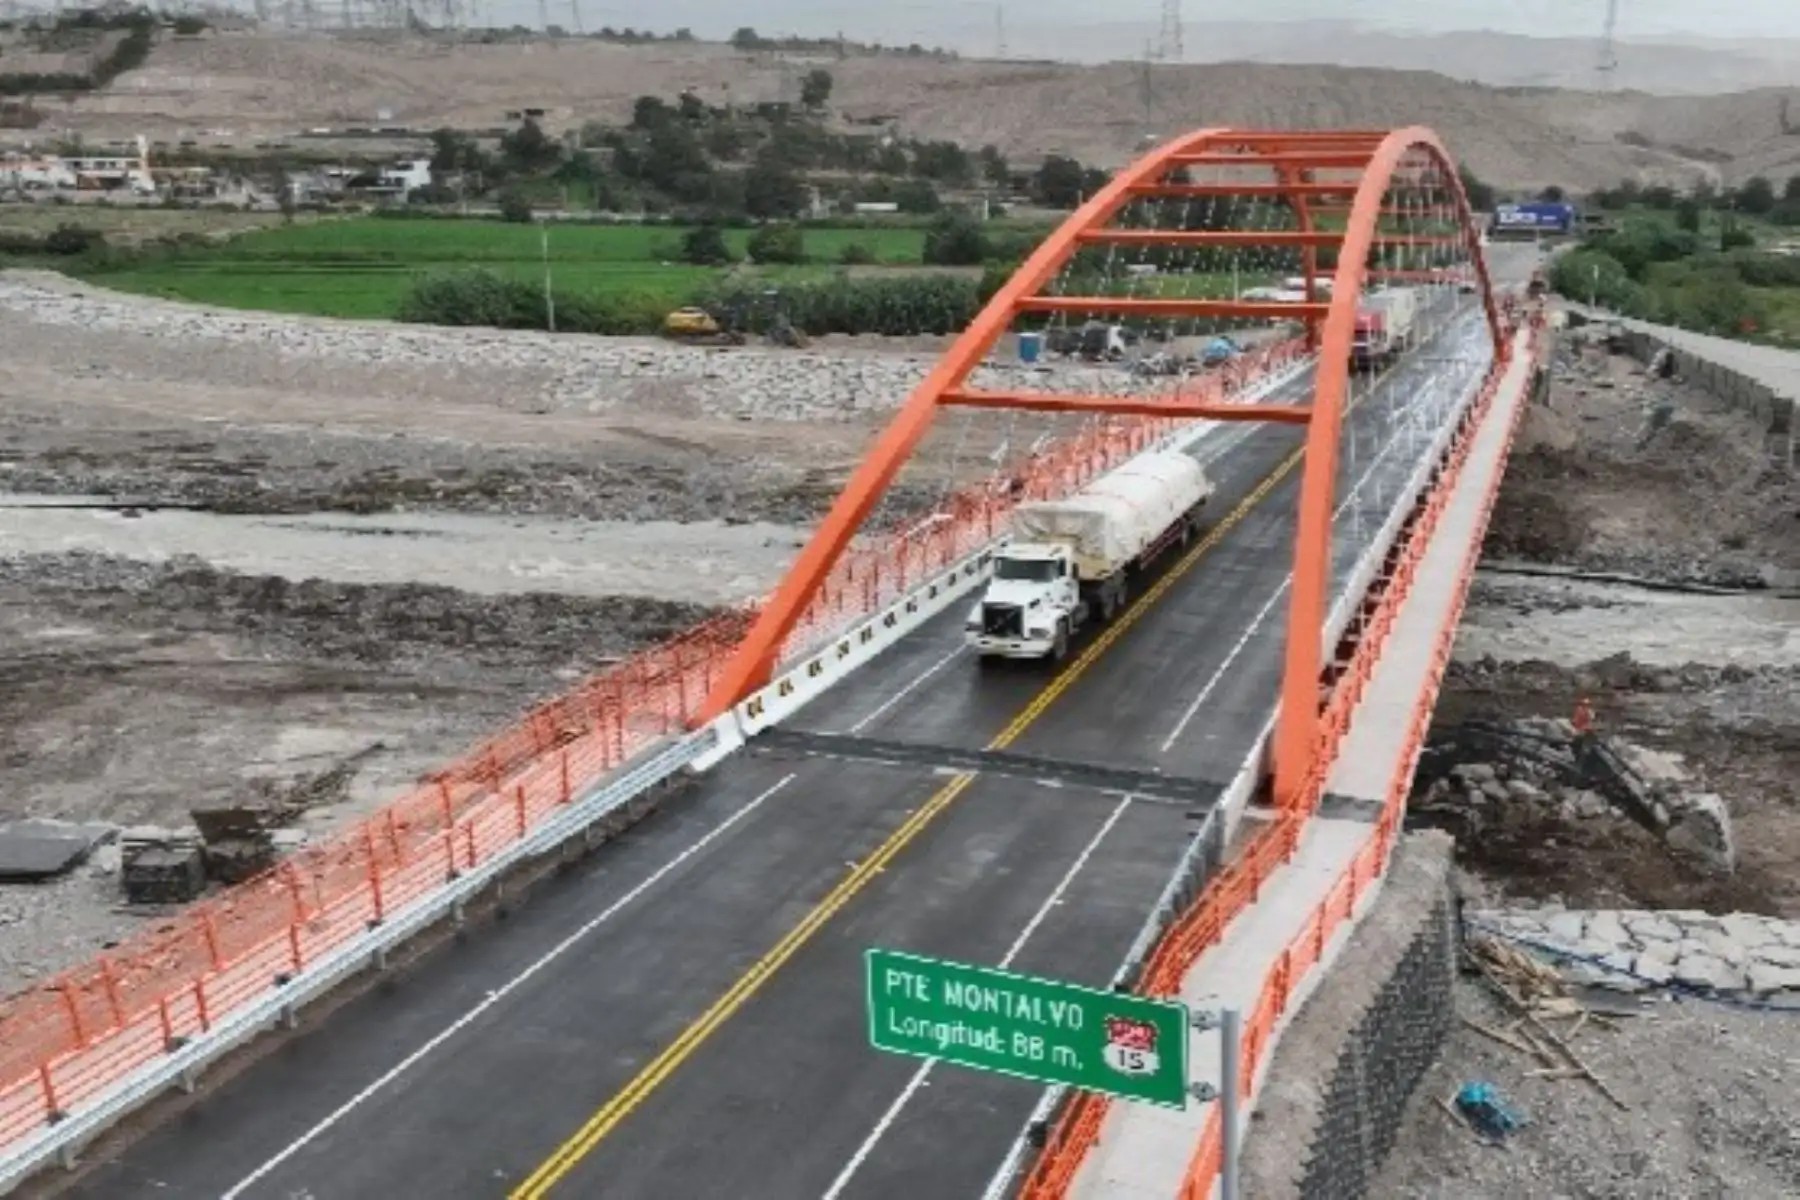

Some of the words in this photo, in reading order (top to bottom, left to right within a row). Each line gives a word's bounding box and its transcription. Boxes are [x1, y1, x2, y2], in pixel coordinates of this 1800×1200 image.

[886, 968, 931, 1002] PTE
[944, 978, 1084, 1031] MONTALVO
[1118, 1048, 1145, 1070] 15
